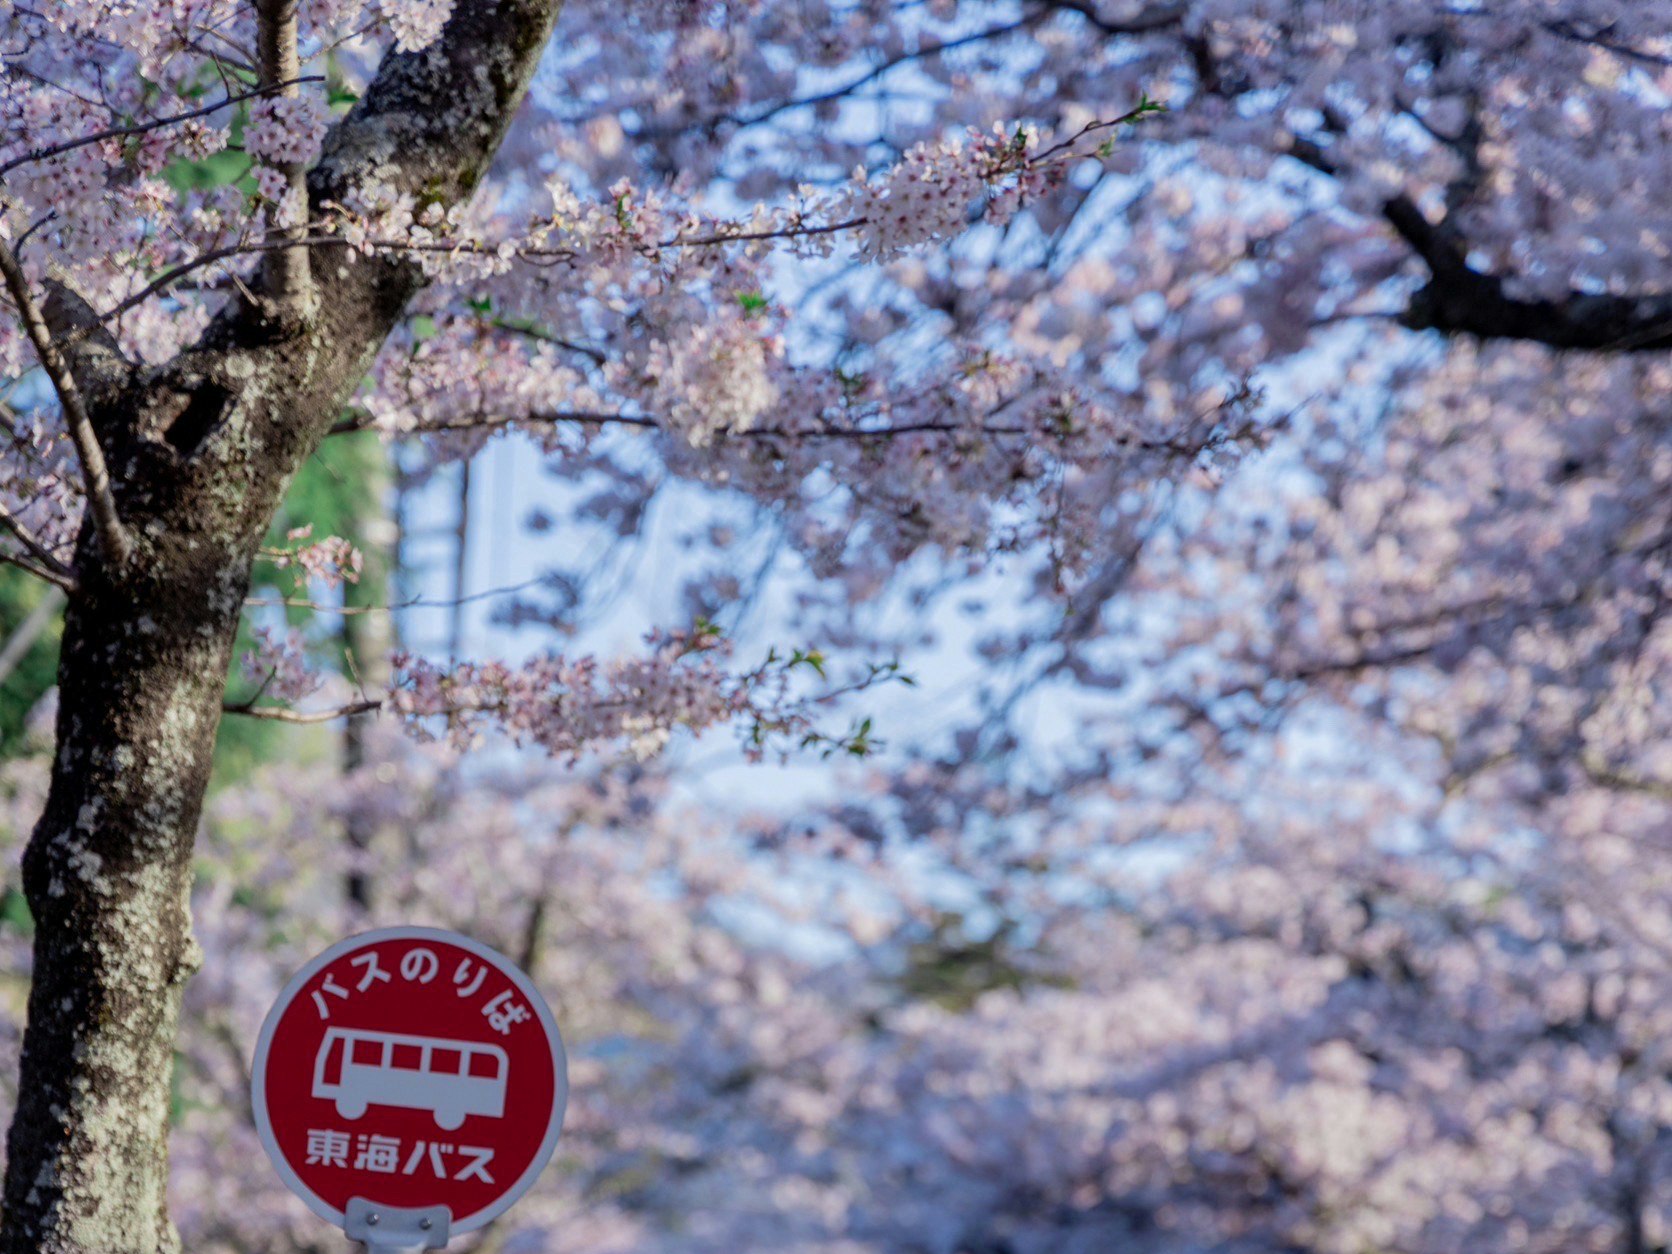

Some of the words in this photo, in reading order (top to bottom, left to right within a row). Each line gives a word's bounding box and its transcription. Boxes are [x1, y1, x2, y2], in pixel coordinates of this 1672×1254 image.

[311, 948, 531, 1035] バスのりば
[305, 1129, 496, 1184] 東海バス
